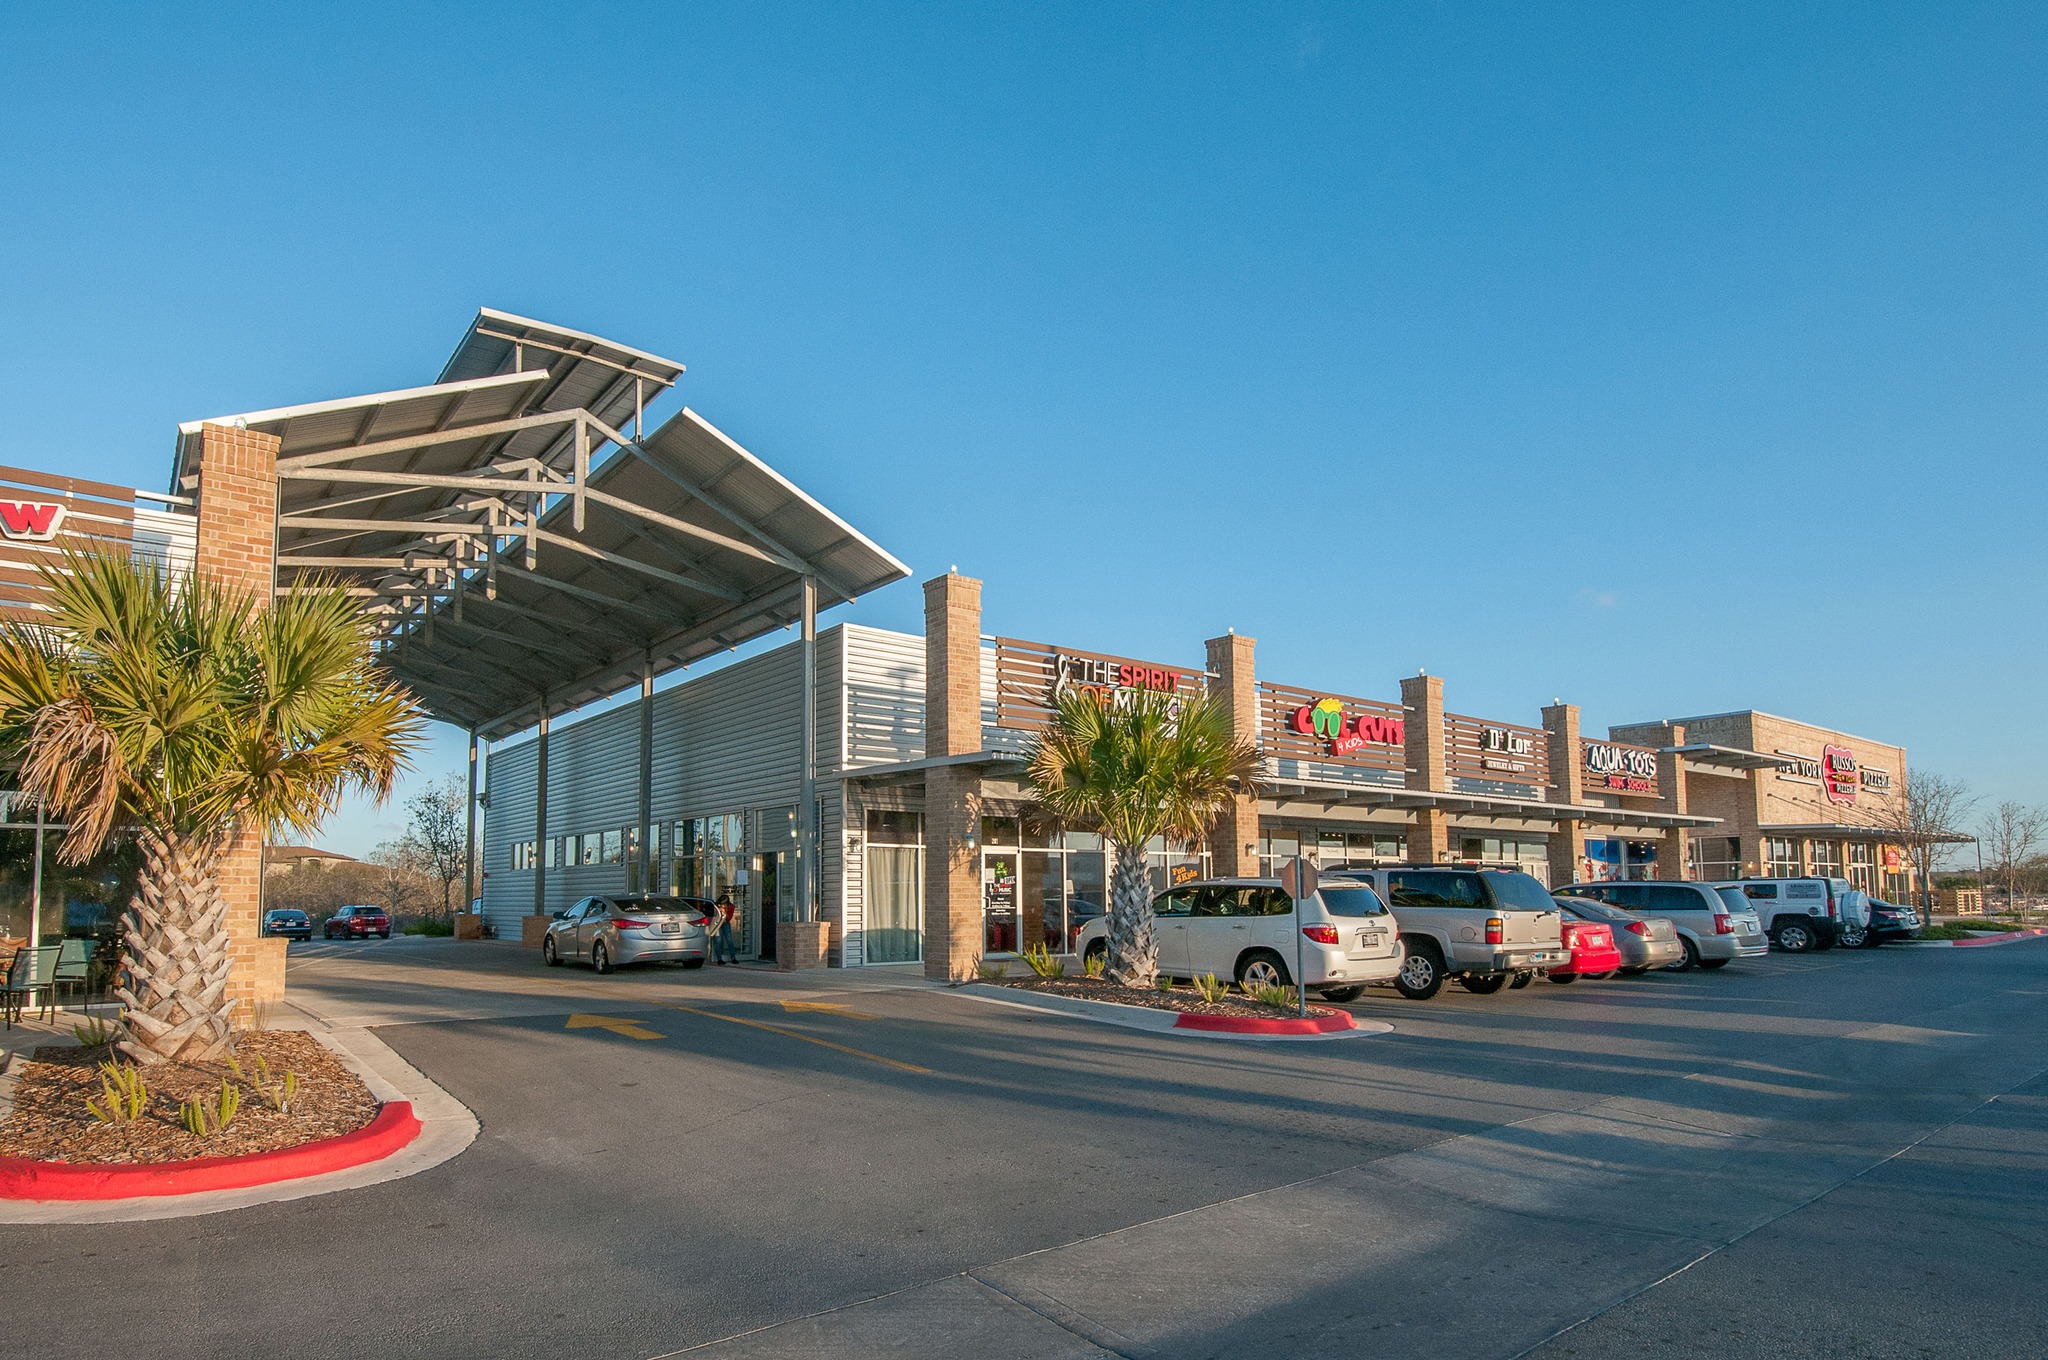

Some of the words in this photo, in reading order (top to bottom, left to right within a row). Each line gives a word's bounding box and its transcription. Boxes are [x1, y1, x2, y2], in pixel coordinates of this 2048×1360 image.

[1080, 658, 1120, 685] THE
[1120, 664, 1182, 693] SPIRIT
[1338, 742, 1344, 752] 4
[1345, 737, 1364, 749] KIDS
[1172, 866, 1186, 876] Fun
